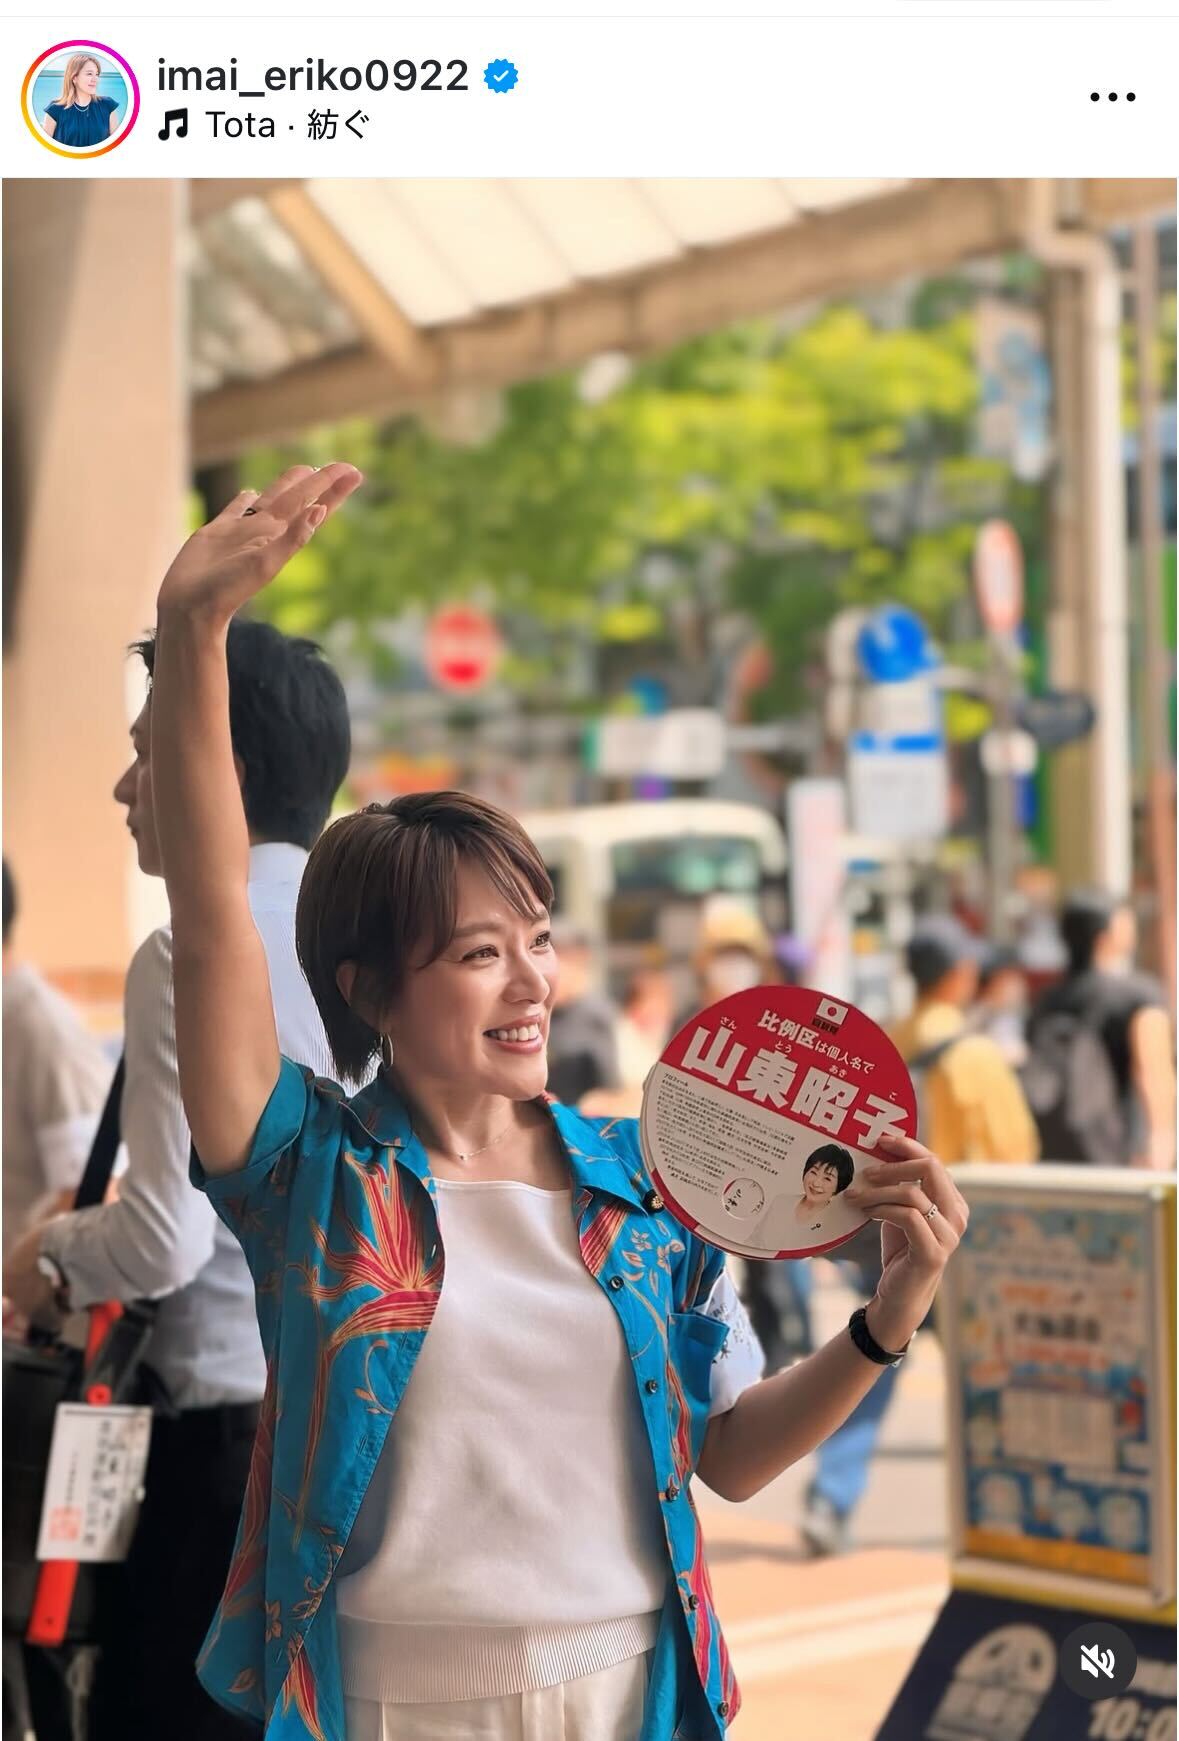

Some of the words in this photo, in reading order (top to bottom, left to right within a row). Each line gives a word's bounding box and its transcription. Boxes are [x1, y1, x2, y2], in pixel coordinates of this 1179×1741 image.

[720, 1016, 737, 1030] さん
[757, 1009, 876, 1074] 比例区は個人名で
[775, 1040, 792, 1053] とう
[829, 1064, 848, 1078] あき
[681, 1025, 909, 1149] 山東昭子
